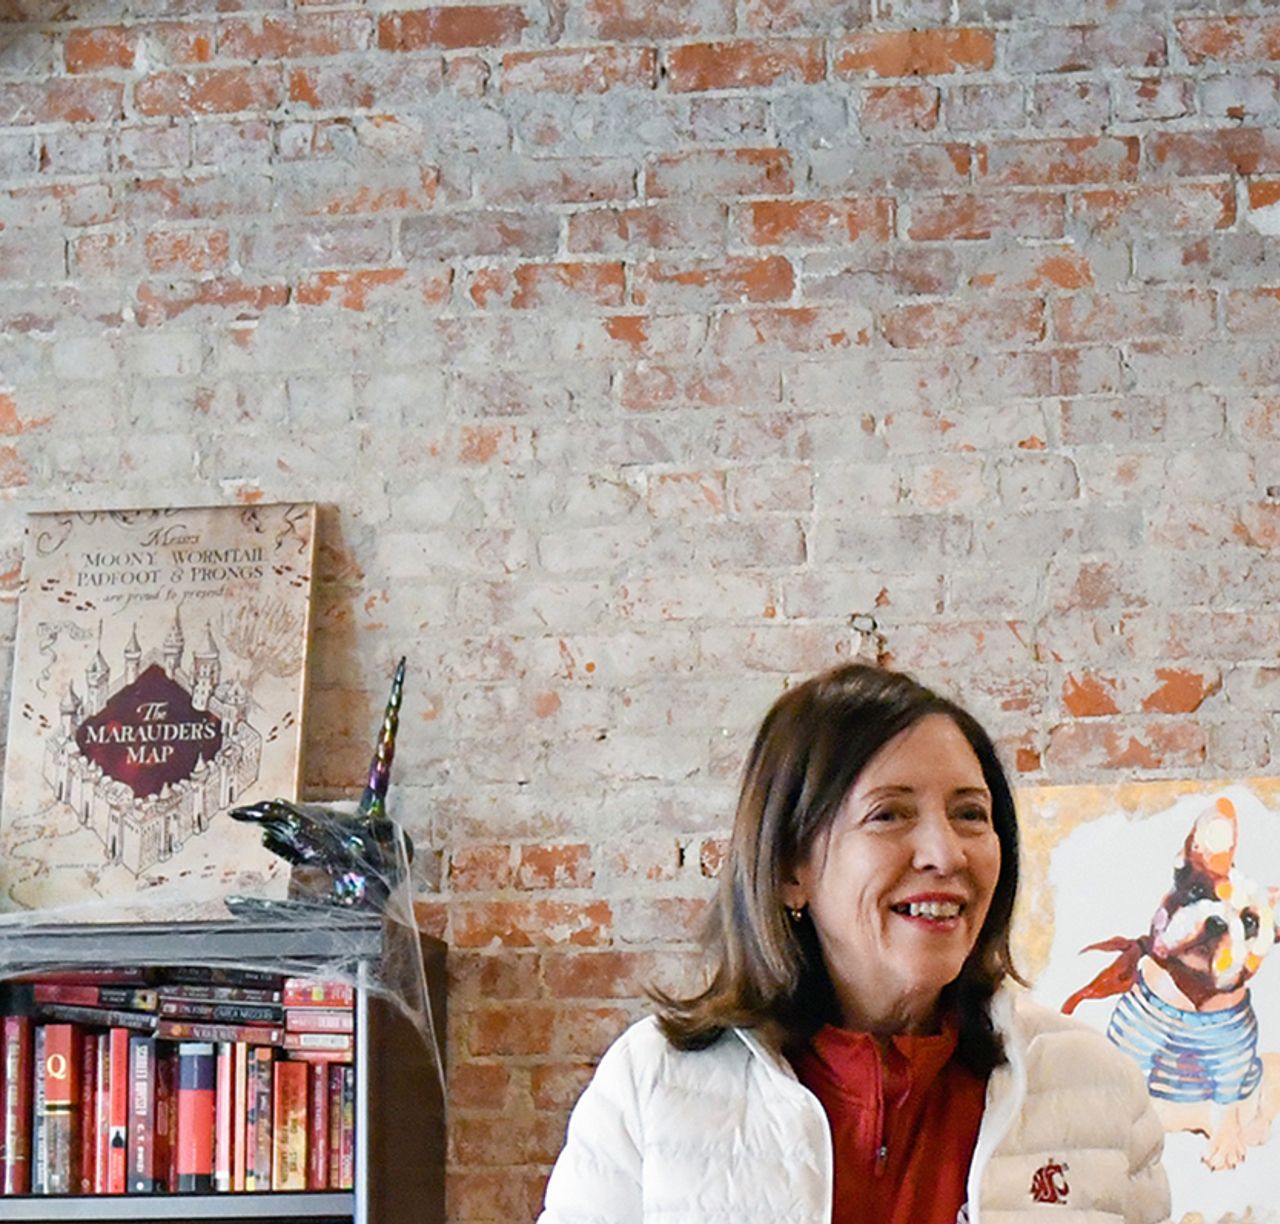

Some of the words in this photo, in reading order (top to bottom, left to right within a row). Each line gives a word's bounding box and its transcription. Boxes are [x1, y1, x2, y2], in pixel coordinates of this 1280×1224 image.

[83, 551, 157, 568] MOONY
[170, 548, 265, 565] WORMTAIL
[76, 569, 161, 587] PADFOOT
[170, 569, 184, 584] &
[191, 565, 265, 583] PRONGS
[136, 701, 169, 721] The
[85, 718, 217, 744] MARAUDER'S
[125, 745, 175, 765] MAP
[46, 1054, 67, 1080] Q
